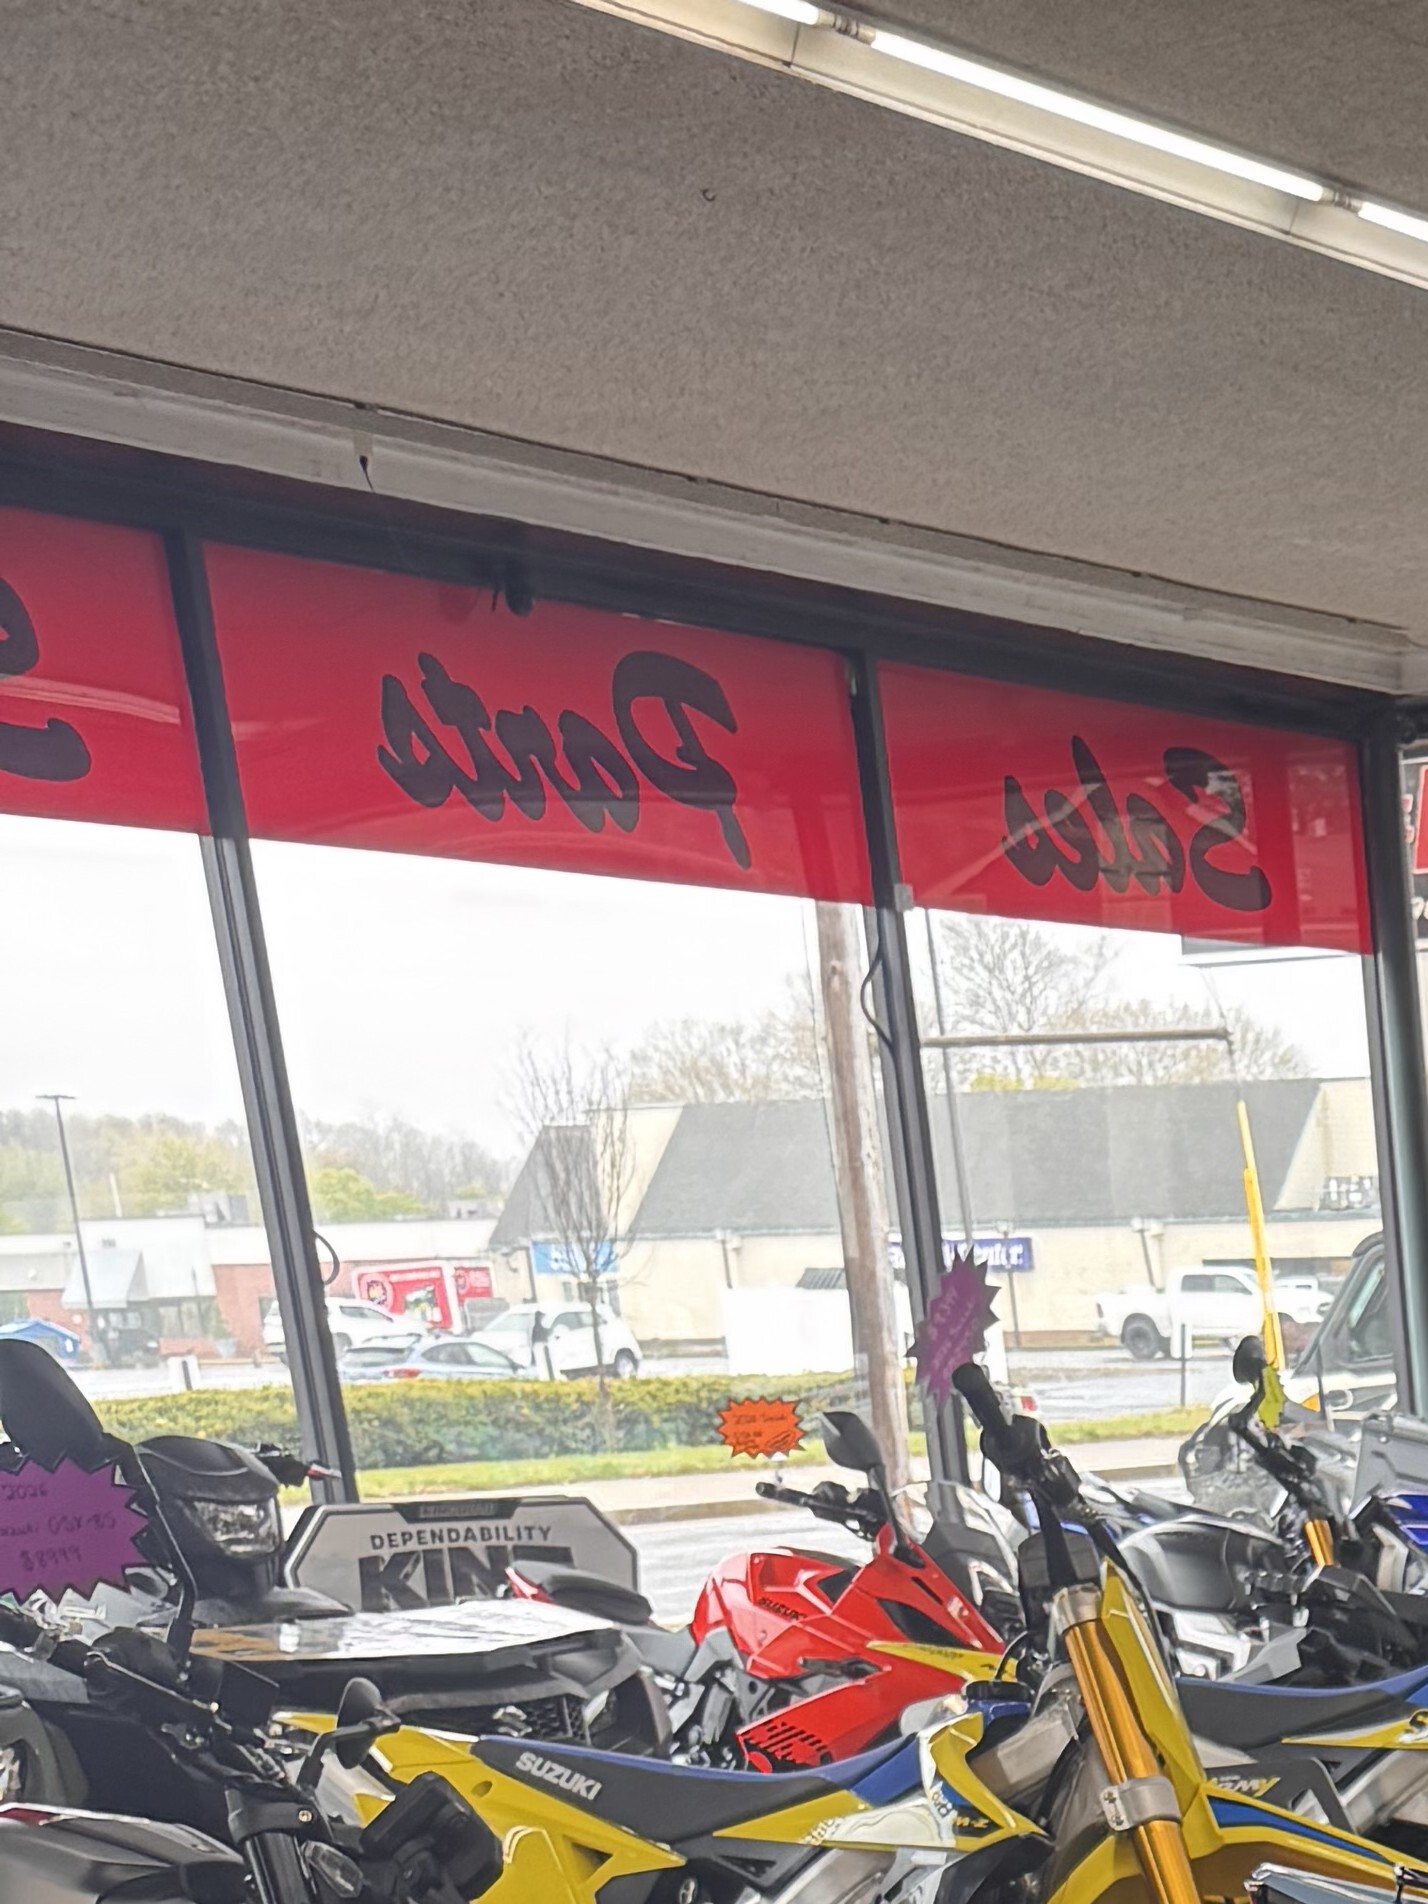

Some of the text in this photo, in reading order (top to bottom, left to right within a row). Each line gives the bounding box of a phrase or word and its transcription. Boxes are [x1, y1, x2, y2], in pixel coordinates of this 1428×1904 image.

[370, 1525, 553, 1551] DEPENDABILITY
[359, 1546, 577, 1613] KIN
[514, 1751, 603, 1801] SUZUKI
